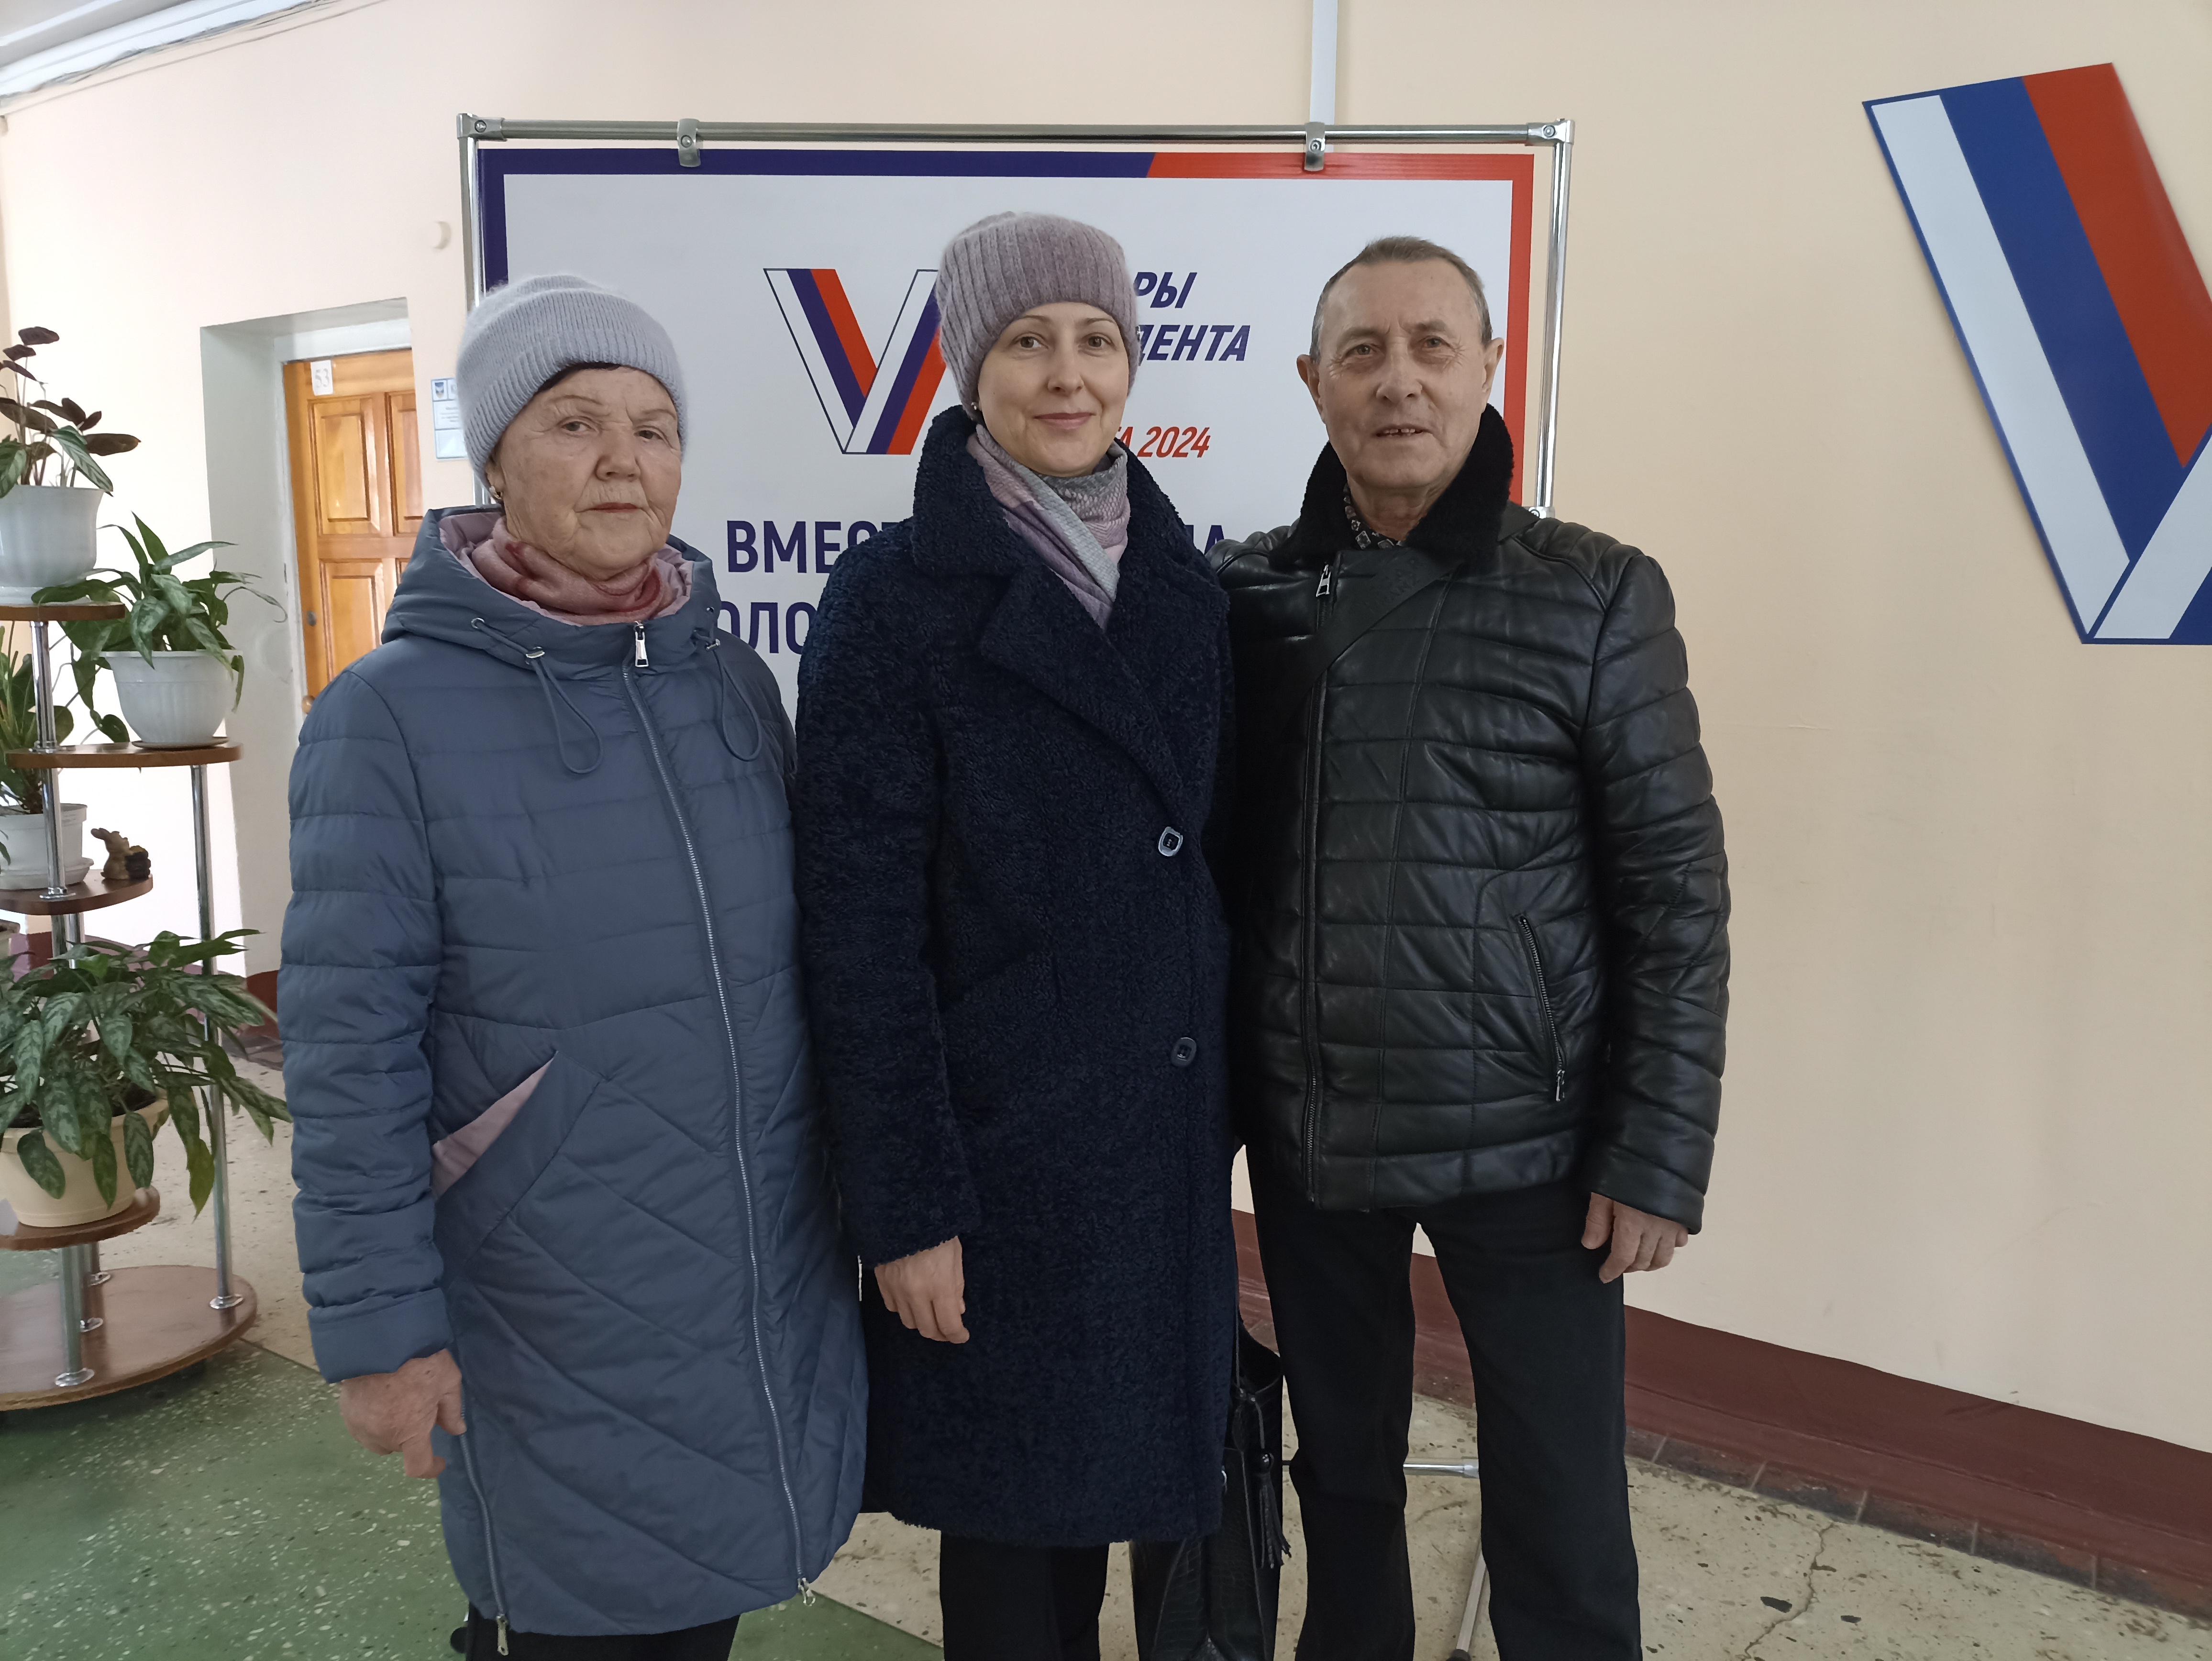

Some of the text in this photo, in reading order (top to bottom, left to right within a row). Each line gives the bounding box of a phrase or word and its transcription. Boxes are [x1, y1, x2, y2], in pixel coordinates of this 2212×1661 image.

[1133, 271, 1197, 309] РЫ
[315, 368, 330, 388] 53
[1137, 426, 1211, 458] 2024
